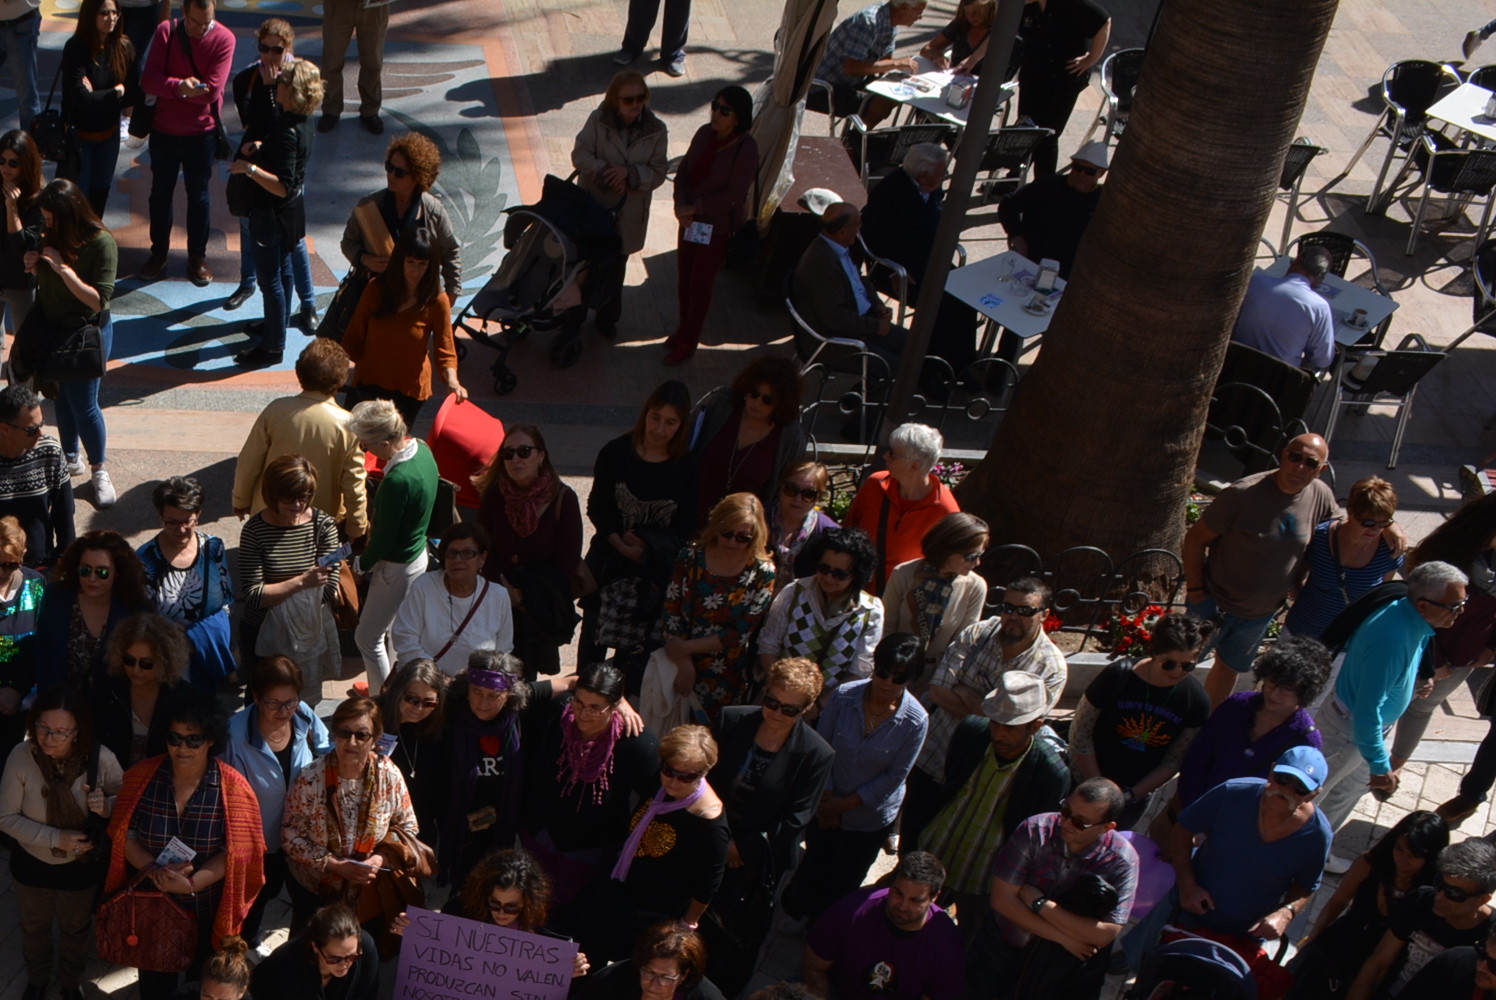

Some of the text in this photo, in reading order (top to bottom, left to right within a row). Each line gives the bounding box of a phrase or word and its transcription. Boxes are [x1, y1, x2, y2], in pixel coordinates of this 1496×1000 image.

[416, 915, 560, 964] SI NUESTRAS
[413, 944, 474, 971] VIDAS
[482, 960, 507, 977] NO
[407, 965, 496, 998] PRODUZCAN
